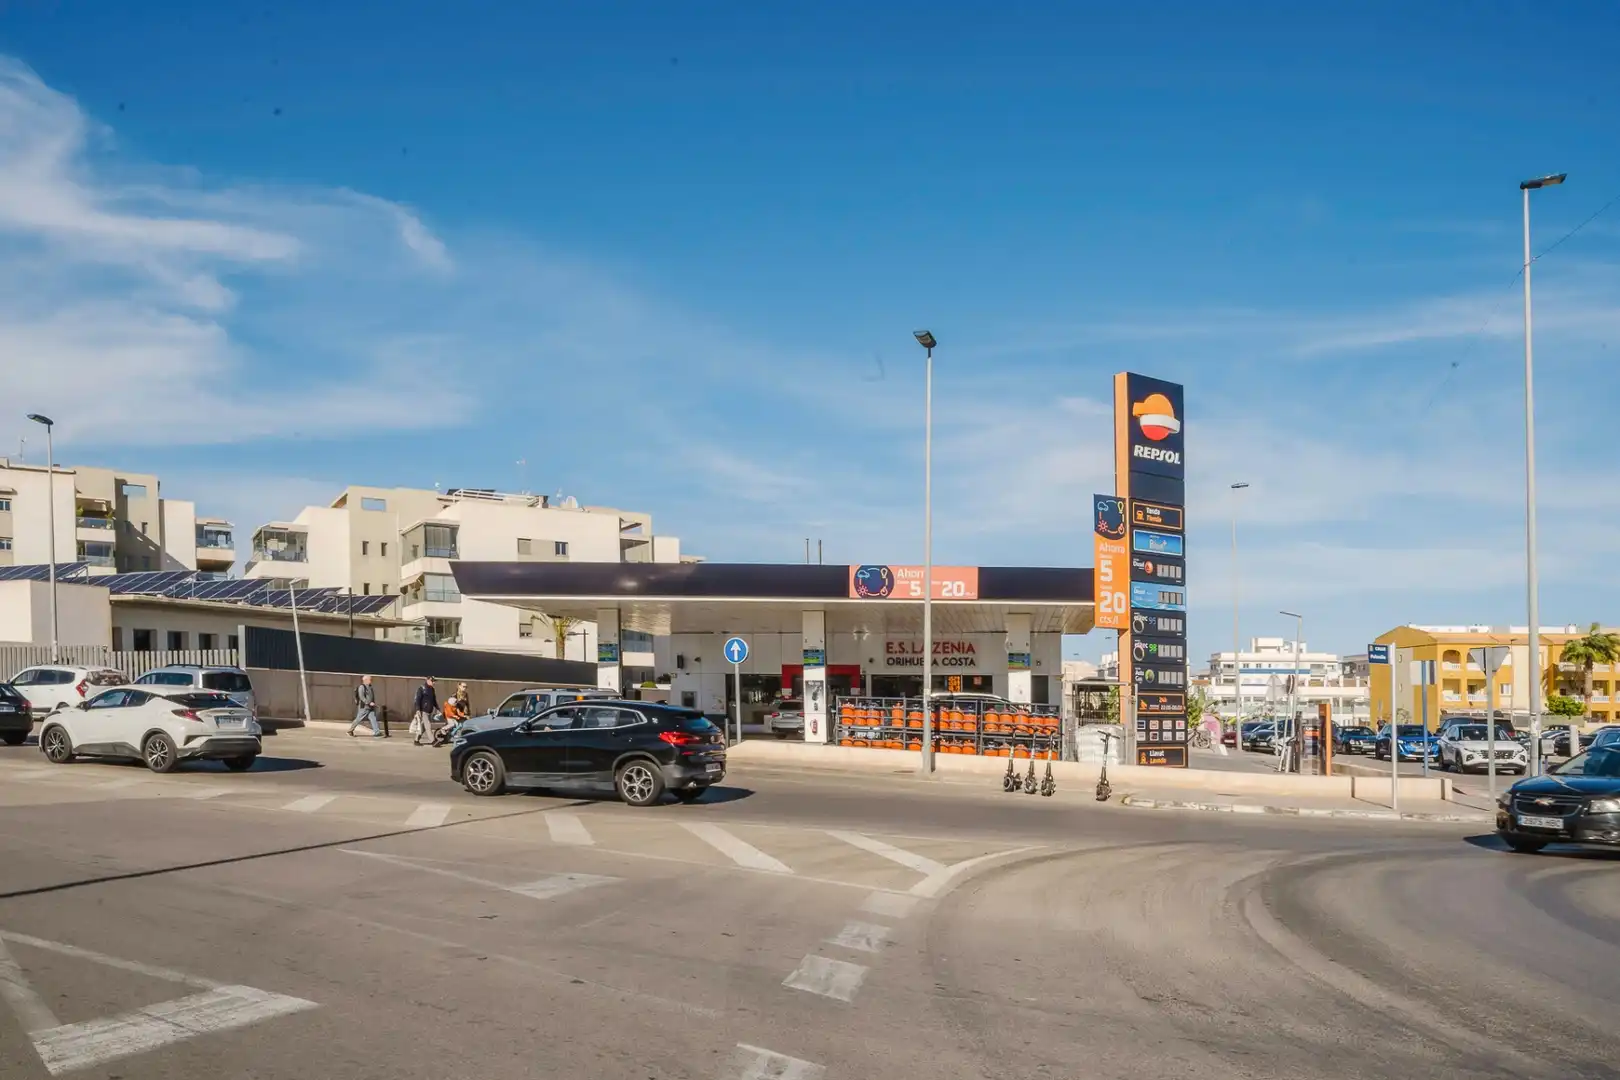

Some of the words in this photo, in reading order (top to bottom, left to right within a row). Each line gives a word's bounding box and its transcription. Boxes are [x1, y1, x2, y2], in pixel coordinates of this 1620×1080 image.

[1134, 445, 1180, 464] REPSOL
[898, 569, 924, 578] Ahorr
[1100, 560, 1113, 582] 5
[910, 581, 921, 596] 5
[942, 581, 965, 596] 20
[1100, 591, 1126, 614] 20
[1149, 616, 1156, 625] 95
[886, 642, 909, 654] E.S.
[932, 642, 976, 654] ZENIA
[1149, 643, 1157, 652] 98
[886, 657, 939, 667] ORIHUEA
[941, 657, 976, 667] COSTA
